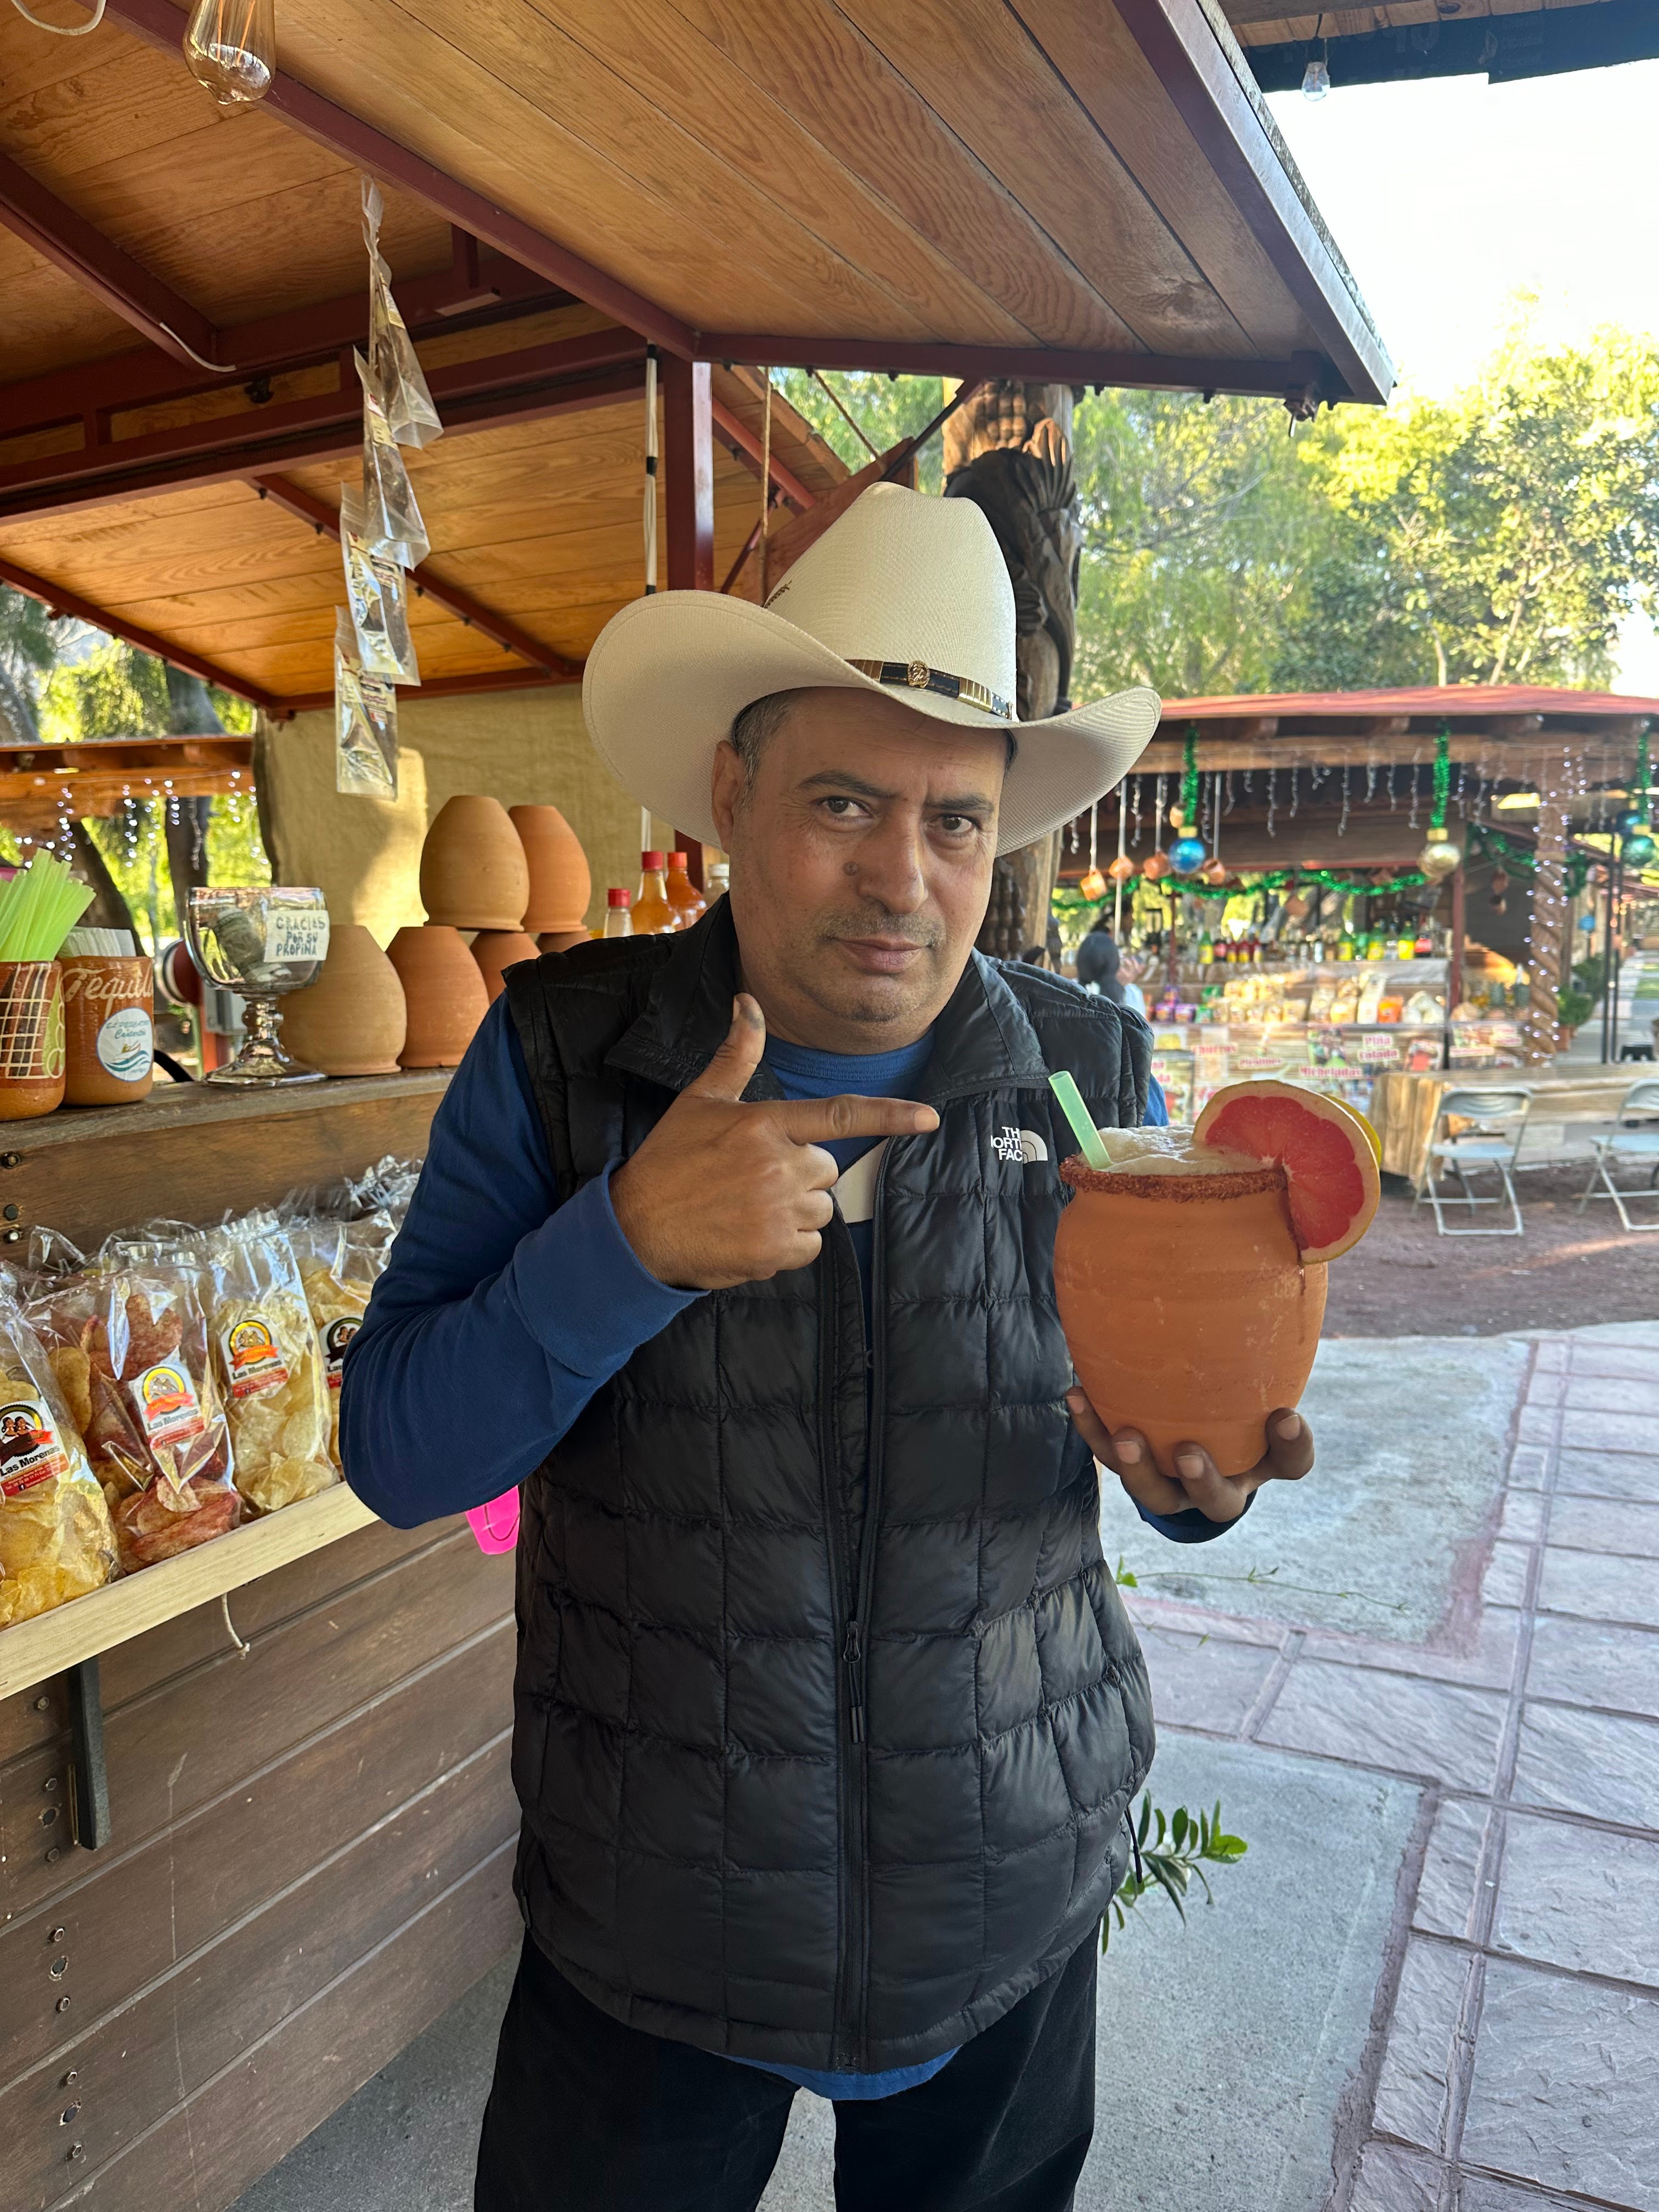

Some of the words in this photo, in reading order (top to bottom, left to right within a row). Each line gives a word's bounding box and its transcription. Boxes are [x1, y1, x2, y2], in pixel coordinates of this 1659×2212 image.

[276, 916, 326, 931] GRACIAS
[286, 931, 303, 944] POR
[307, 932, 318, 944] SU
[1001, 1126, 1020, 1139] TH
[998, 1148, 1023, 1161] FAC
[147, 1421, 163, 1431] Las
[163, 1408, 199, 1426] Morenas
[0, 1463, 19, 1477] Las
[19, 1445, 60, 1468] Morenas
